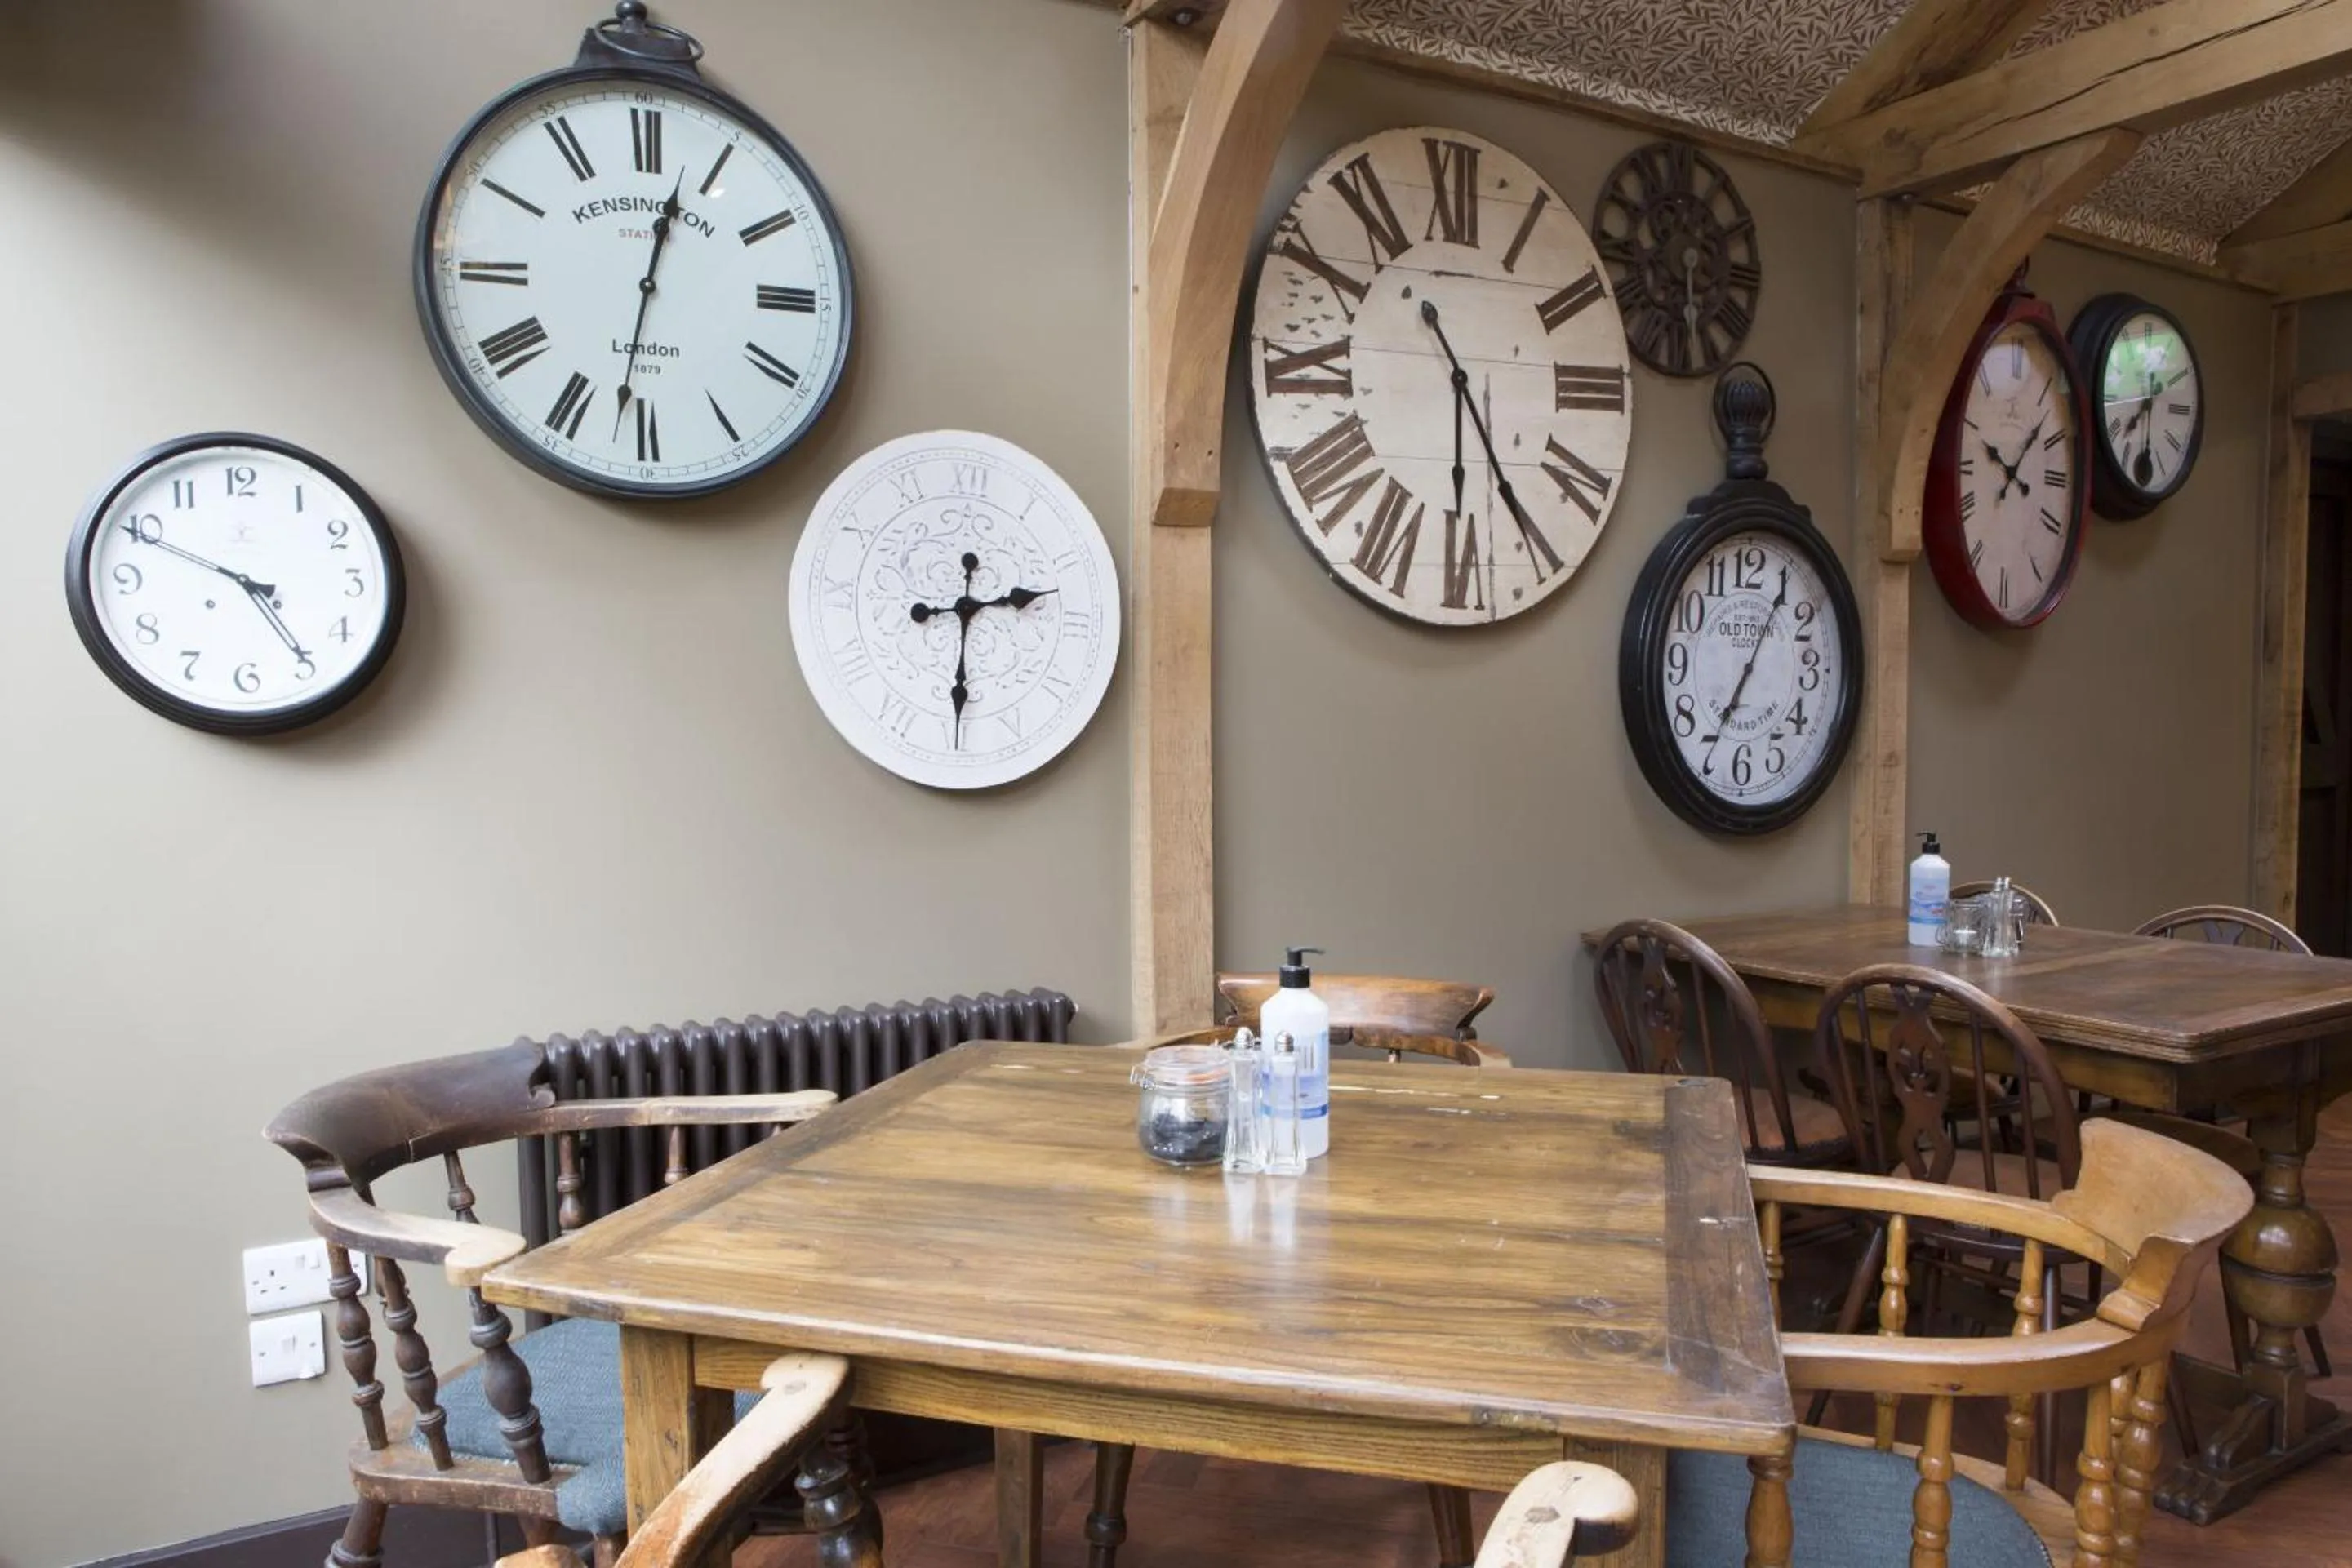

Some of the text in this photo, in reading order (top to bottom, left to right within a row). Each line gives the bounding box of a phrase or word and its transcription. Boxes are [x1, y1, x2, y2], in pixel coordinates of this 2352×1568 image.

[538, 101, 557, 118] 55
[635, 91, 653, 104] 60
[630, 108, 661, 174] XII
[1328, 152, 1413, 273] XI
[1422, 138, 1480, 248] XII
[619, 229, 669, 242] STATI
[1279, 222, 1372, 324] X
[757, 285, 816, 313] III
[1535, 264, 1607, 335] II
[612, 339, 680, 358] London
[1263, 335, 1353, 398] IX
[1554, 361, 1625, 415] III
[225, 466, 257, 497] 12
[1286, 410, 1385, 537] VIII
[1541, 433, 1612, 526] IV
[173, 479, 195, 509] 11
[295, 485, 303, 513] 1
[129, 513, 163, 544] 10
[327, 520, 349, 549] 2
[1351, 475, 1426, 598] VII
[113, 562, 143, 595] 9
[1440, 509, 1485, 611] VI
[1705, 553, 1726, 597] 11
[1733, 548, 1767, 589] 12
[343, 569, 365, 598] 3
[1777, 566, 1790, 605] 1
[136, 614, 160, 645] 8
[327, 615, 354, 644] 4
[1673, 590, 1705, 633] 10
[1719, 622, 1774, 638] OLD TOWN
[1794, 601, 1815, 642] 2
[180, 651, 201, 681] 7
[233, 663, 261, 693] 6
[294, 651, 316, 680] 5
[1668, 642, 1688, 686] 9
[1798, 649, 1821, 691] 3
[1674, 694, 1696, 737] 8
[1785, 697, 1808, 735] 4
[1701, 735, 1719, 775] 7
[1732, 744, 1752, 786] 6
[1765, 732, 1785, 774] 5
